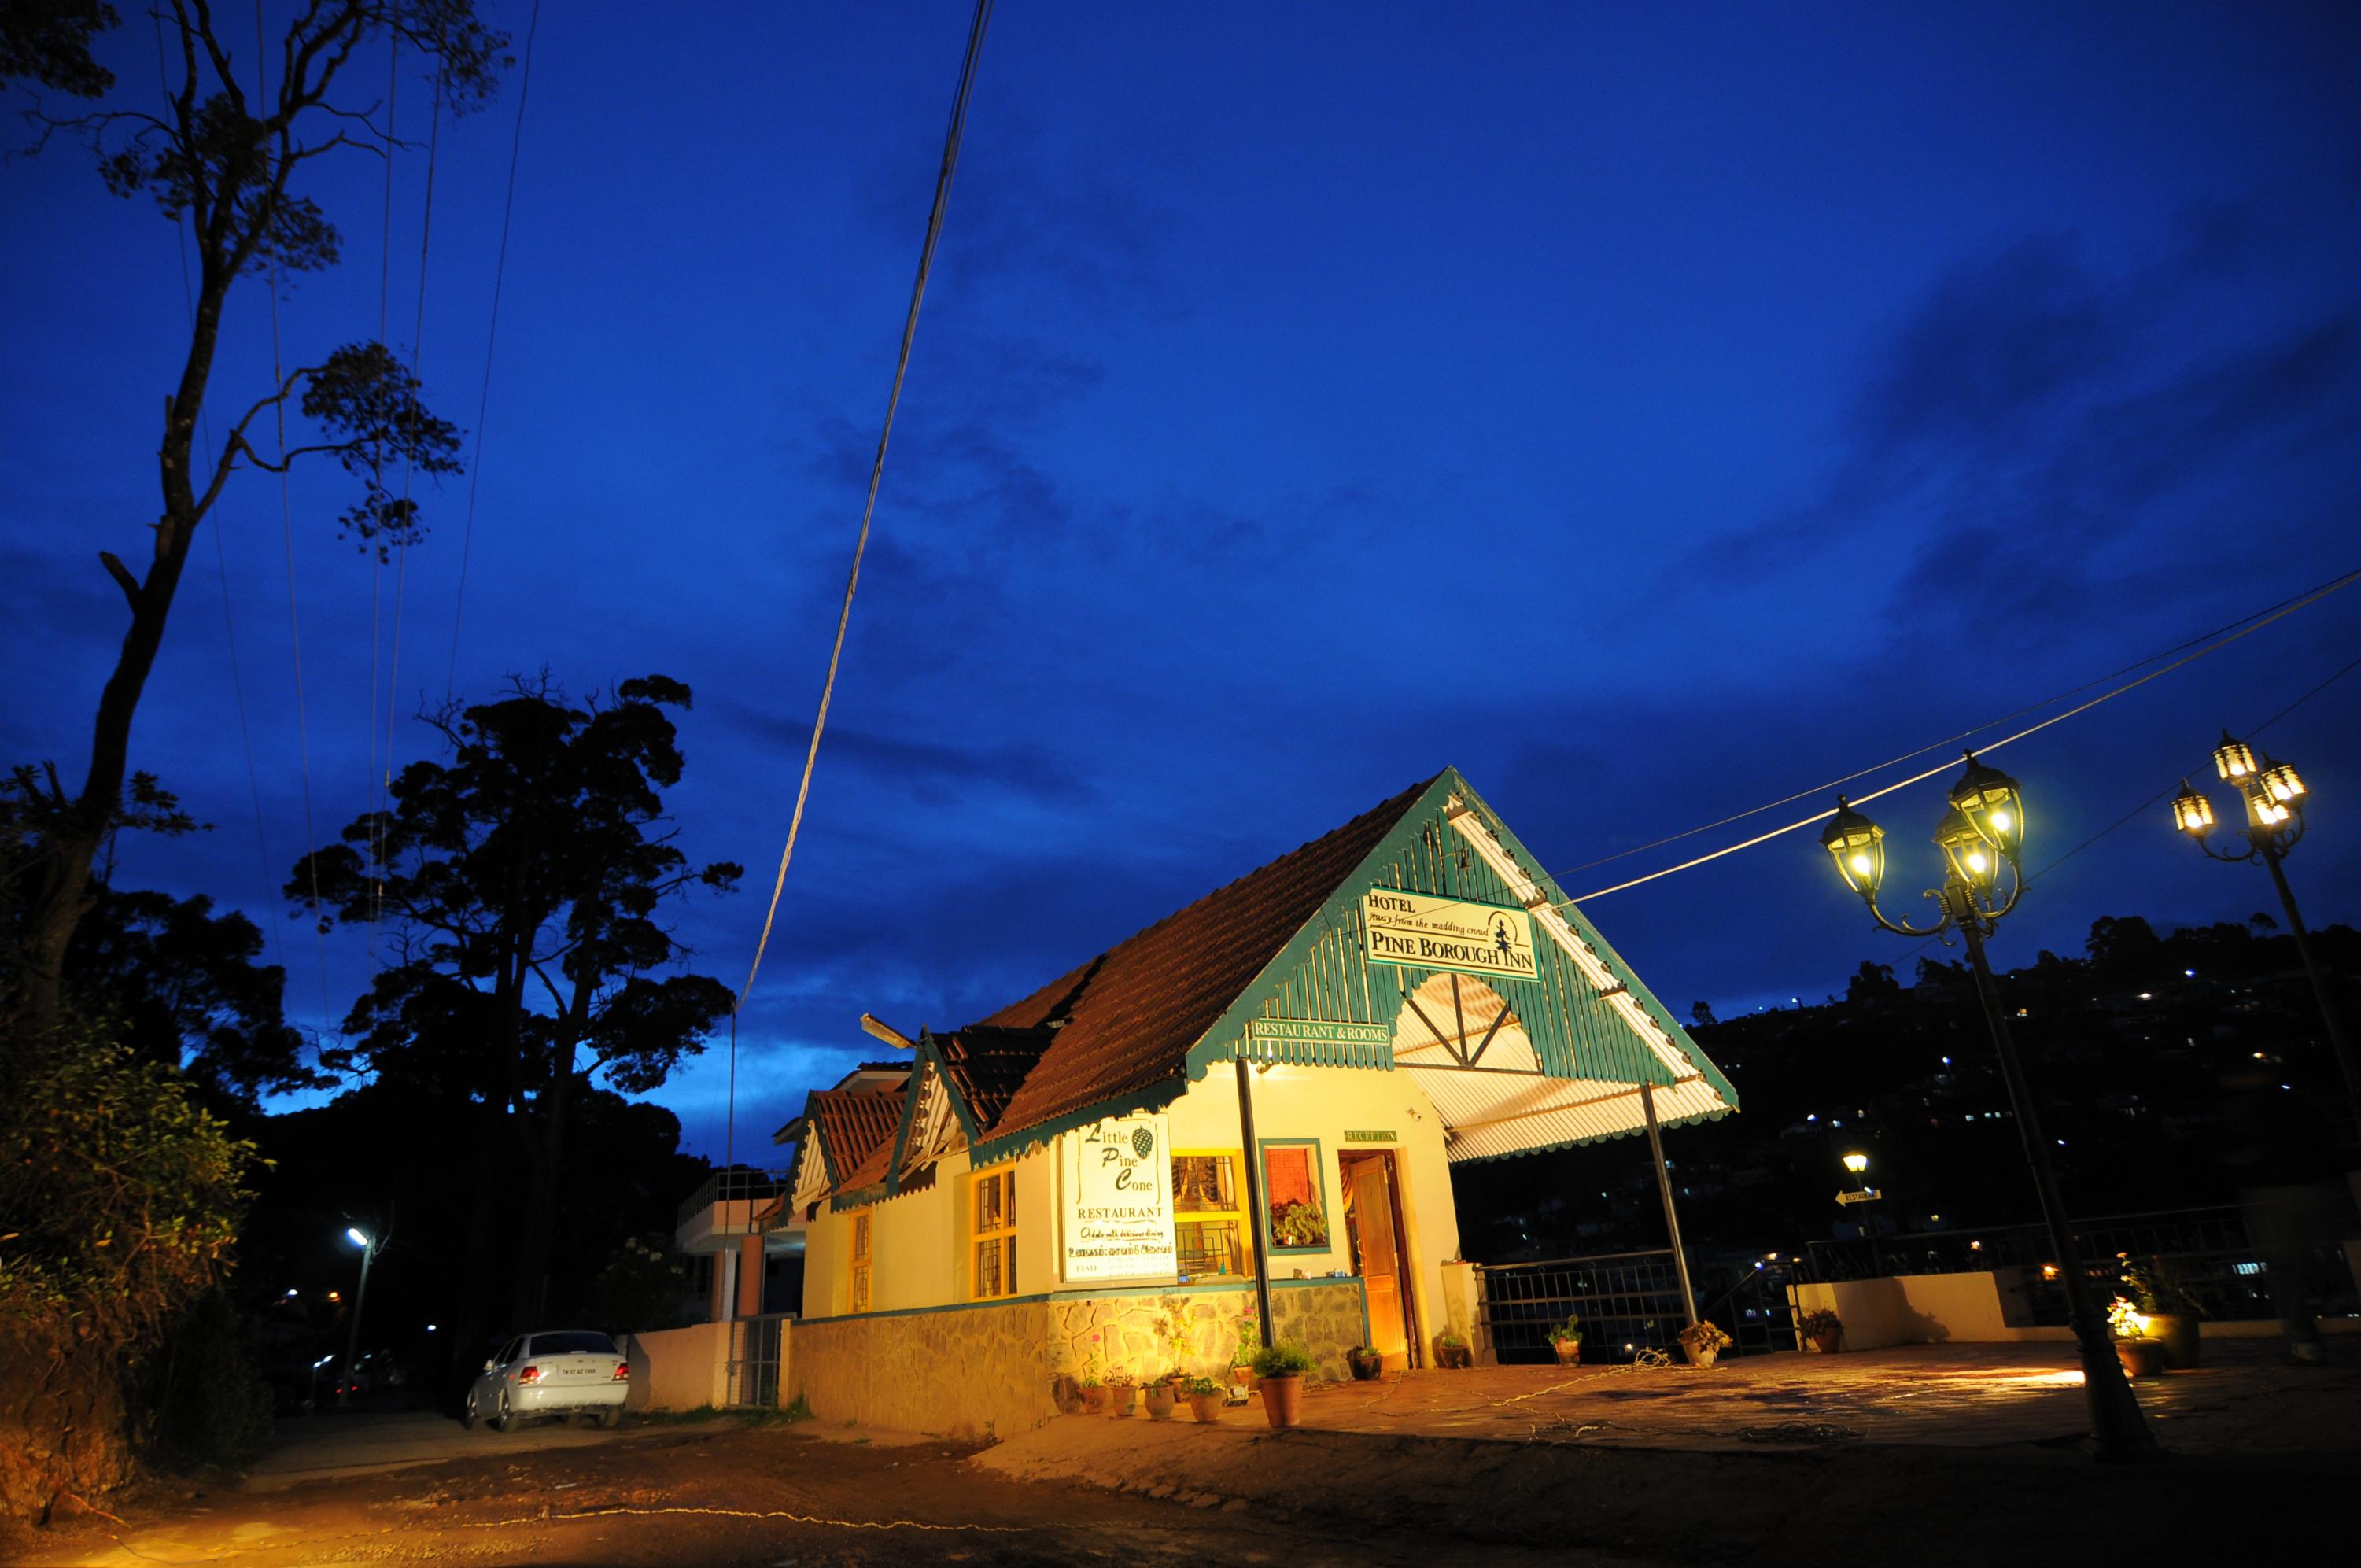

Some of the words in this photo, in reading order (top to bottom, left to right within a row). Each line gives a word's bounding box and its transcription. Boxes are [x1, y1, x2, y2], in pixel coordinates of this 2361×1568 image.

[1368, 895, 1415, 913] HOTEL
[1393, 914, 1413, 926] from
[1416, 919, 1429, 928] the
[1432, 922, 1465, 935] madding
[1467, 928, 1489, 938] crowd
[1370, 931, 1416, 955] PINE
[1418, 938, 1499, 965] BOROUGH
[1504, 950, 1533, 969] INN
[1255, 1023, 1334, 1039] RESTAURANT
[1337, 1028, 1347, 1039] &
[1348, 1028, 1388, 1041] ROOMS
[1085, 1123, 1128, 1144] Little
[1346, 1131, 1396, 1142] RECEPTION
[1102, 1147, 1138, 1168] Pine
[1115, 1168, 1153, 1191] Cone
[1078, 1207, 1163, 1219] RESTAURANT
[1145, 1227, 1164, 1239] dining
